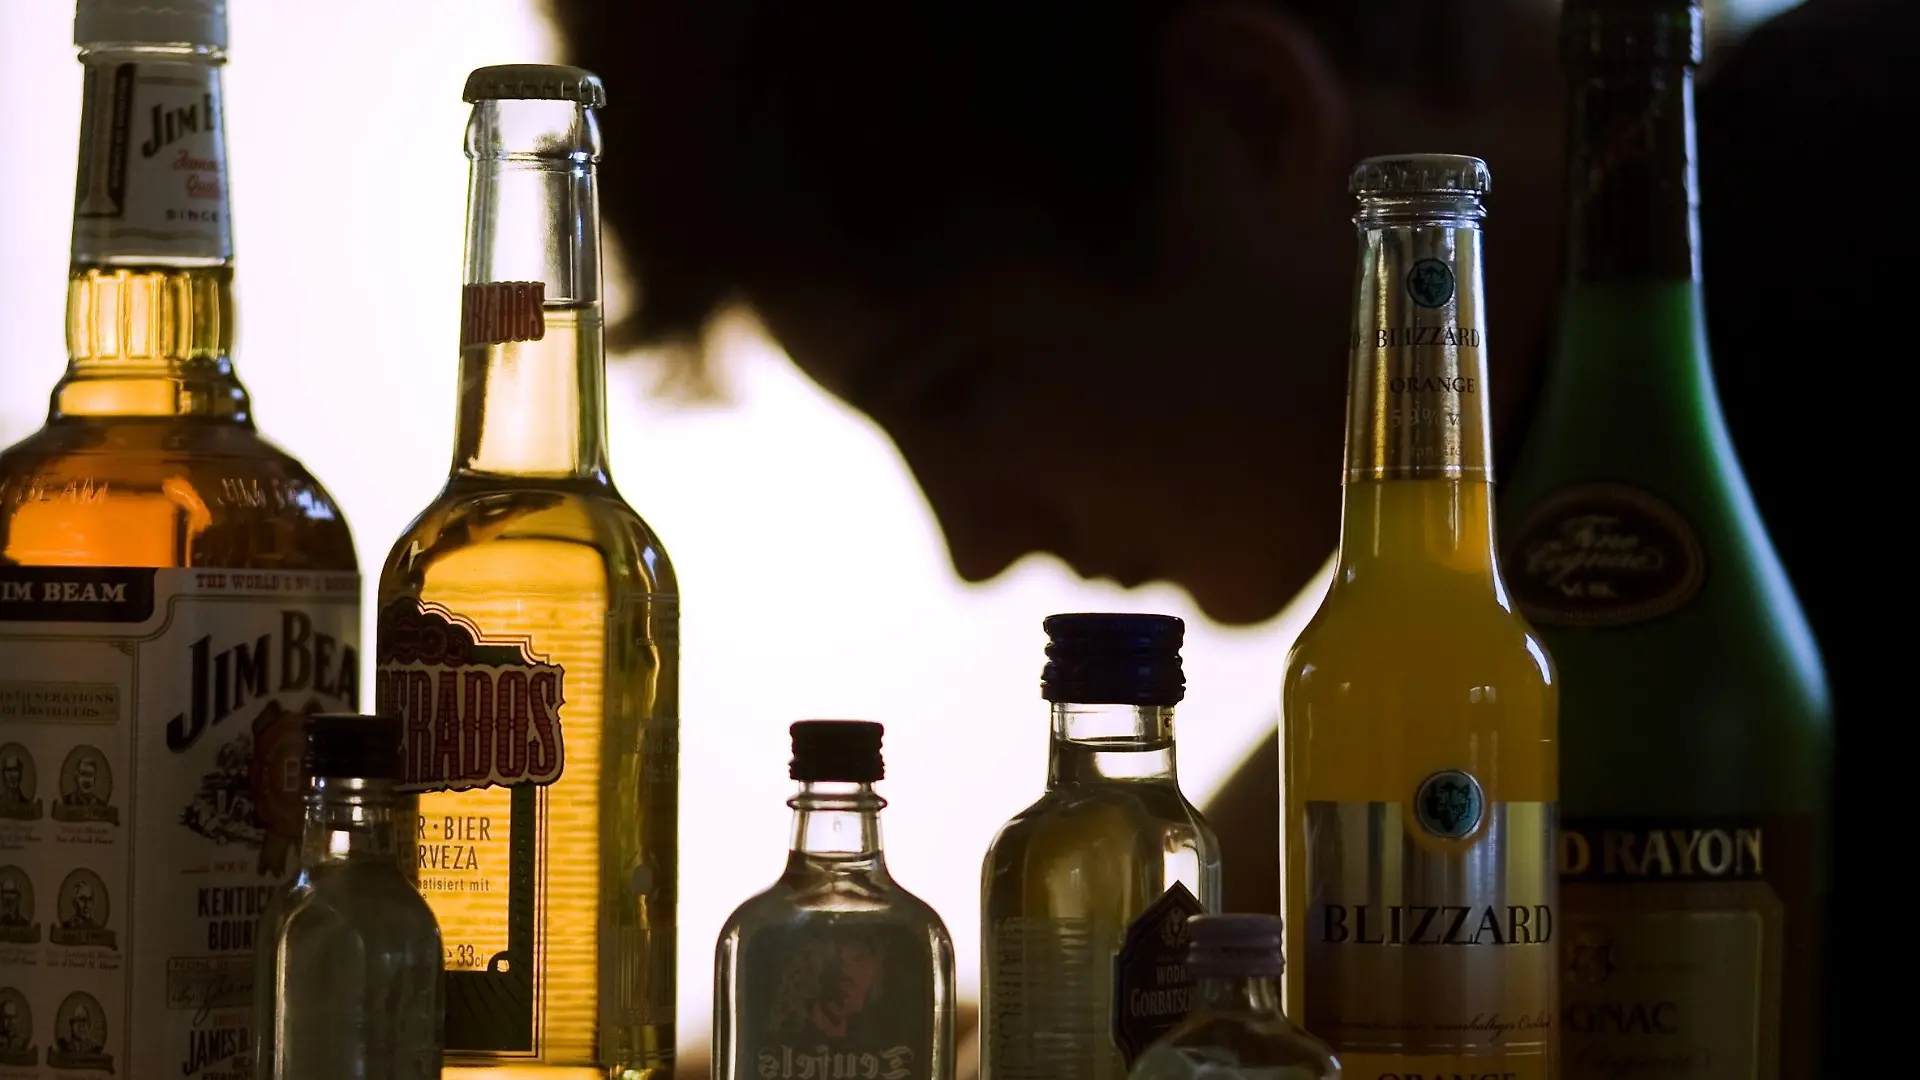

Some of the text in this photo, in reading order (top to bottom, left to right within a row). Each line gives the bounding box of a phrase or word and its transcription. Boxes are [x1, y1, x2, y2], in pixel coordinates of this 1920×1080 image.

[142, 103, 198, 158] JIM
[465, 283, 545, 343] RADOS
[1376, 327, 1480, 348] BLIZZARD
[1390, 377, 1475, 393] ORANGE
[44, 582, 127, 602] BEAM
[167, 634, 269, 752] JIM
[444, 816, 491, 841] BIER
[1602, 828, 1763, 877] RAYON
[469, 878, 490, 891] mit
[208, 920, 258, 951] BOUR
[1322, 904, 1552, 945] BLIZZARD
[183, 1028, 236, 1077] JAMES
